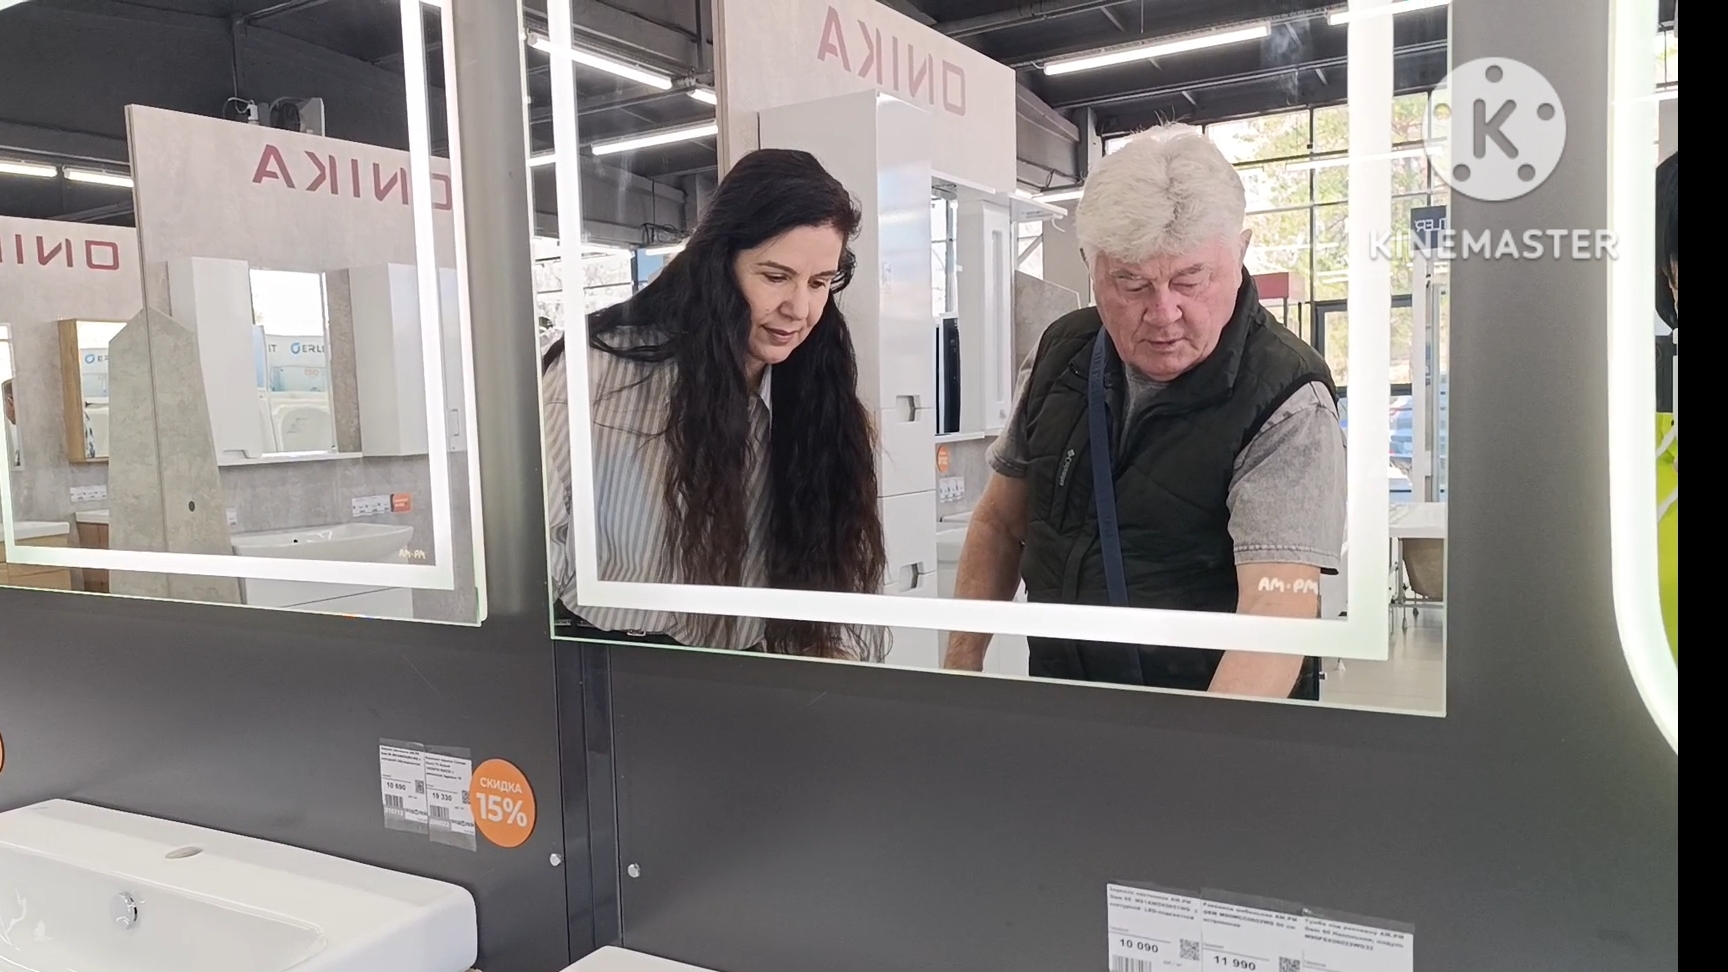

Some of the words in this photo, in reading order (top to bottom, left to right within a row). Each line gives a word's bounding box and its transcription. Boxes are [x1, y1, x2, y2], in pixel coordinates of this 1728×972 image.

[480, 777, 522, 794] СКИДКА
[476, 793, 528, 828] 15%
[1120, 939, 1133, 948] 10
[1137, 941, 1159, 953] 090
[1214, 955, 1228, 966] 11
[1232, 958, 1256, 971] 990
